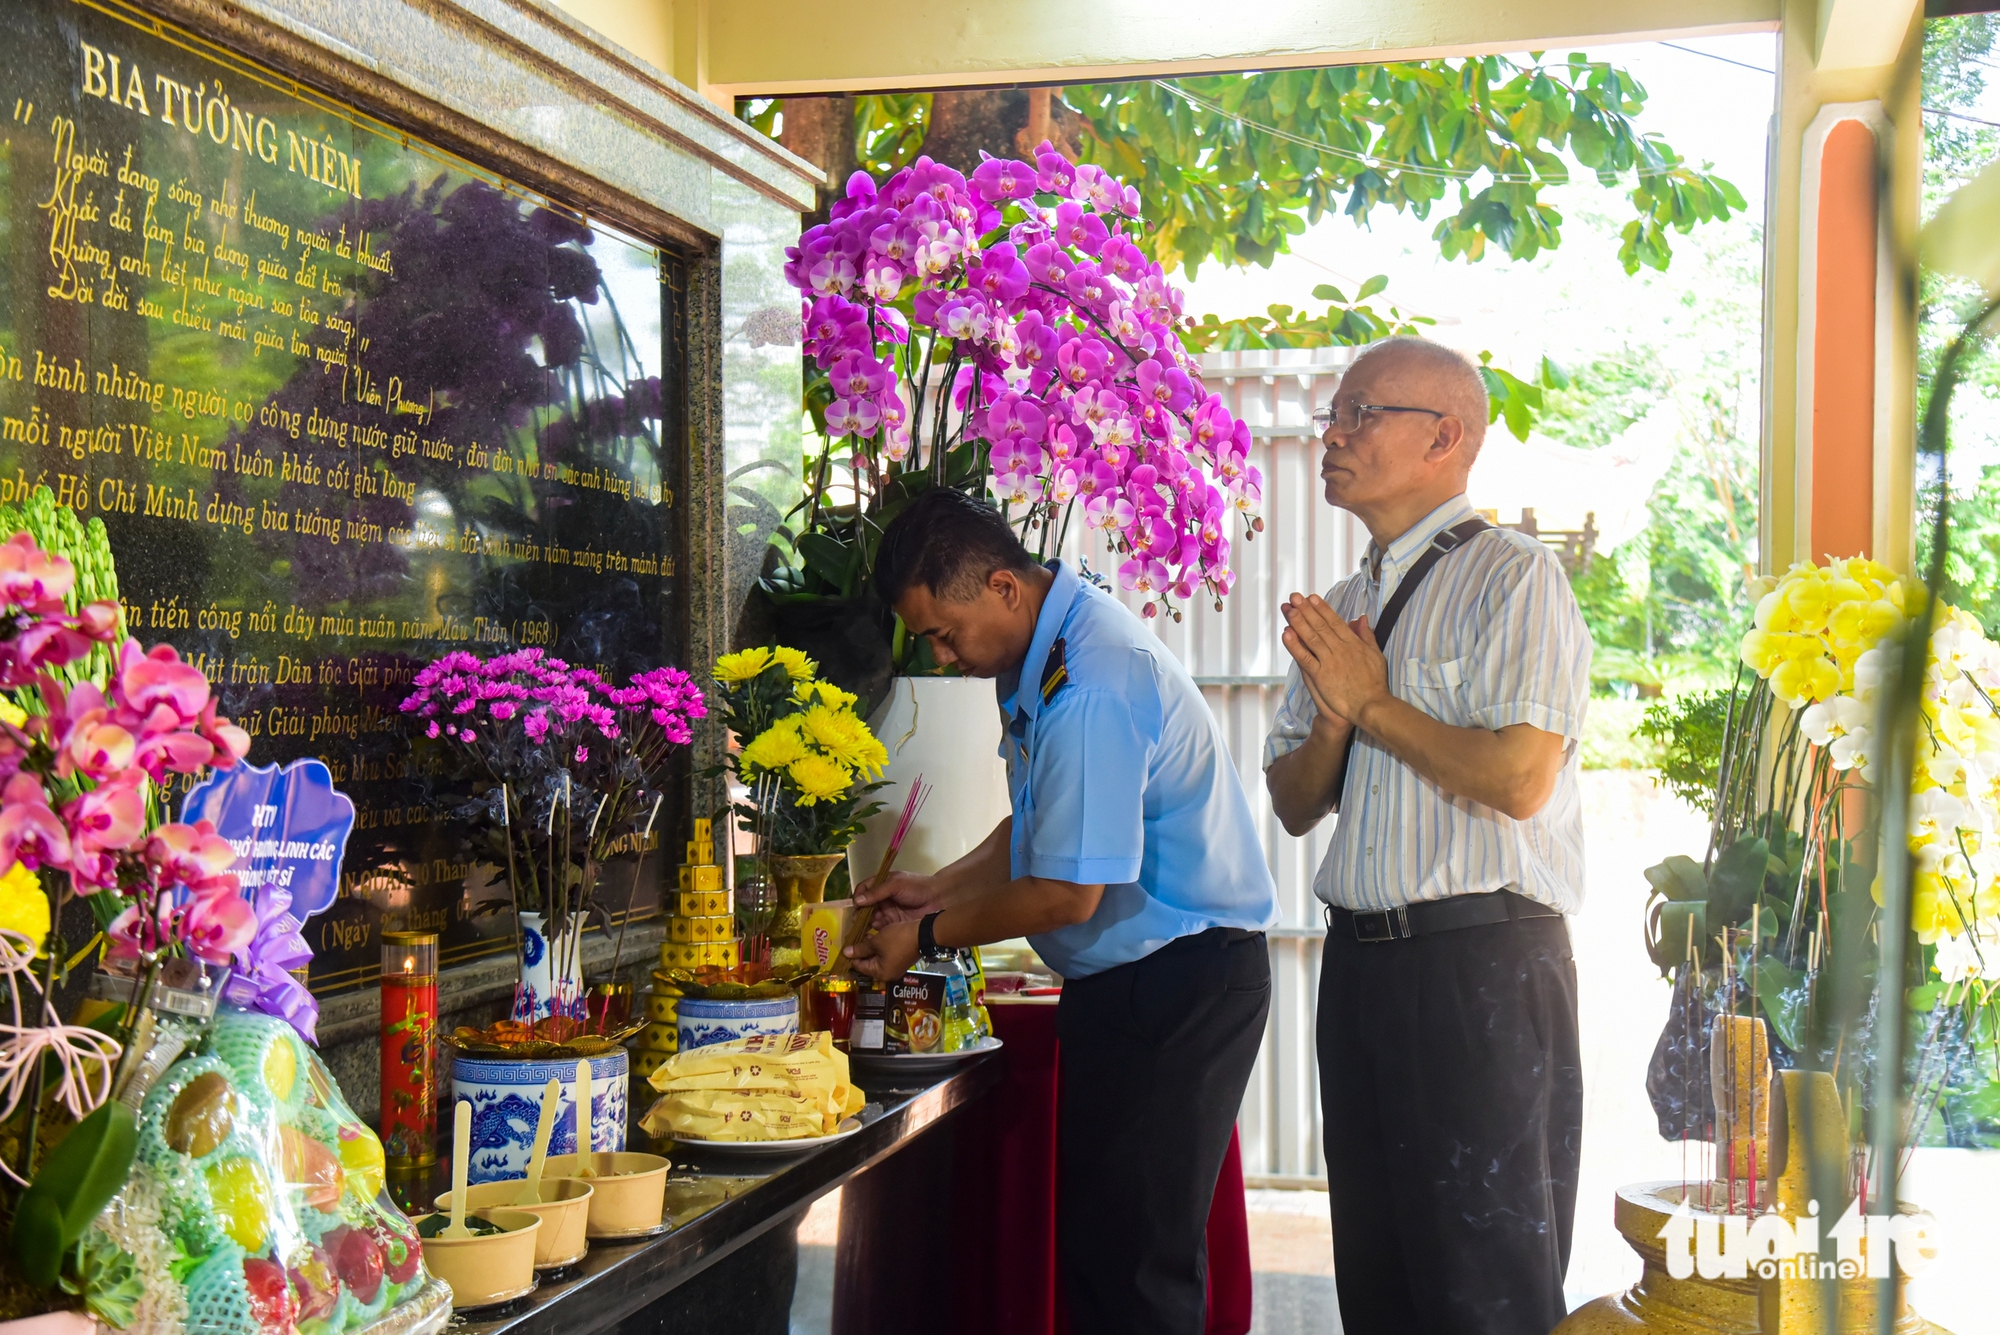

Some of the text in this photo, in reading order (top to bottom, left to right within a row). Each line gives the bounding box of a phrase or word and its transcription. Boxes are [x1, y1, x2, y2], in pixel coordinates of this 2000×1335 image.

[80, 40, 362, 199] BIA TƯỞNG NIỆM
[51, 115, 109, 184] Người
[118, 144, 159, 205] đang
[168, 177, 202, 220] sống
[211, 177, 238, 220] nhớ
[244, 189, 290, 250] thương
[297, 228, 331, 259] người
[335, 223, 351, 259] đã
[38, 166, 100, 222] Khắc
[109, 188, 132, 232] đá
[143, 196, 175, 246] làm
[184, 212, 205, 255] bia
[214, 223, 249, 281] dựng
[258, 253, 289, 285] giữa
[295, 254, 317, 290] đất
[49, 207, 110, 280] Những
[120, 237, 151, 278] anh
[161, 244, 187, 292] liệt
[193, 256, 222, 297] như
[228, 283, 264, 316] ngàn
[271, 298, 293, 317] sao
[47, 248, 94, 304] Đời
[102, 266, 129, 312] đời
[136, 297, 164, 320] sau
[173, 286, 211, 332] chiếu
[219, 319, 247, 342] mãi
[254, 324, 284, 357] giữa
[291, 329, 311, 358] tim
[34, 350, 88, 395] kính
[96, 363, 165, 413] những
[172, 387, 228, 419] người
[234, 395, 254, 423] có
[260, 400, 302, 440] công
[307, 407, 349, 448] dựng
[352, 423, 388, 449] nước
[393, 428, 418, 458] giữ
[466, 441, 489, 469] đời
[492, 447, 513, 473] đời
[561, 463, 579, 486] các
[581, 467, 601, 490] anh
[604, 469, 631, 502] hùng
[662, 481, 674, 508] hy
[3, 406, 49, 446] mỗi
[59, 423, 122, 460] người
[130, 424, 172, 468] Việt
[179, 433, 228, 472] Nam
[234, 443, 274, 479] luôn
[281, 451, 321, 486] khắc
[326, 459, 350, 490] cốt
[353, 466, 378, 499] ghi
[56, 472, 89, 511] Hồ
[99, 477, 136, 514] Chí
[144, 484, 199, 521] Minh
[206, 492, 255, 535] dựng
[261, 498, 289, 532] bia
[294, 507, 342, 545] tưởng
[346, 514, 383, 547] niệm
[388, 521, 412, 546] các
[416, 520, 439, 555] liệt
[444, 528, 456, 552] sĩ
[460, 525, 478, 555] đã
[482, 533, 510, 558] vĩnh
[514, 534, 540, 562] viễn
[544, 537, 571, 565] nằm
[573, 542, 603, 575] xuống
[605, 550, 628, 571] trên
[630, 551, 658, 575] mảnh
[660, 553, 676, 577] đất
[151, 594, 190, 629] tiến
[198, 602, 242, 639] công
[249, 599, 277, 633] nổi
[283, 604, 315, 642] dậy
[321, 610, 355, 638] mùa
[358, 613, 396, 639] xuân
[401, 616, 434, 640] năm
[436, 615, 469, 647] Mậu
[472, 616, 509, 643] Thân
[231, 655, 270, 691] trận
[275, 655, 312, 685] Dân
[319, 658, 342, 692] tộc
[348, 657, 378, 690] Giải
[382, 658, 420, 692] phó
[268, 706, 306, 737] Giải
[310, 705, 359, 741] phóng
[352, 754, 380, 781] khu
[252, 804, 278, 828] HTV
[277, 841, 309, 859] LINH
[309, 839, 336, 861] CÁC
[630, 830, 660, 853] NIM
[279, 866, 296, 887] SĨ
[407, 904, 448, 932] tháng
[814, 926, 830, 966] Solite
